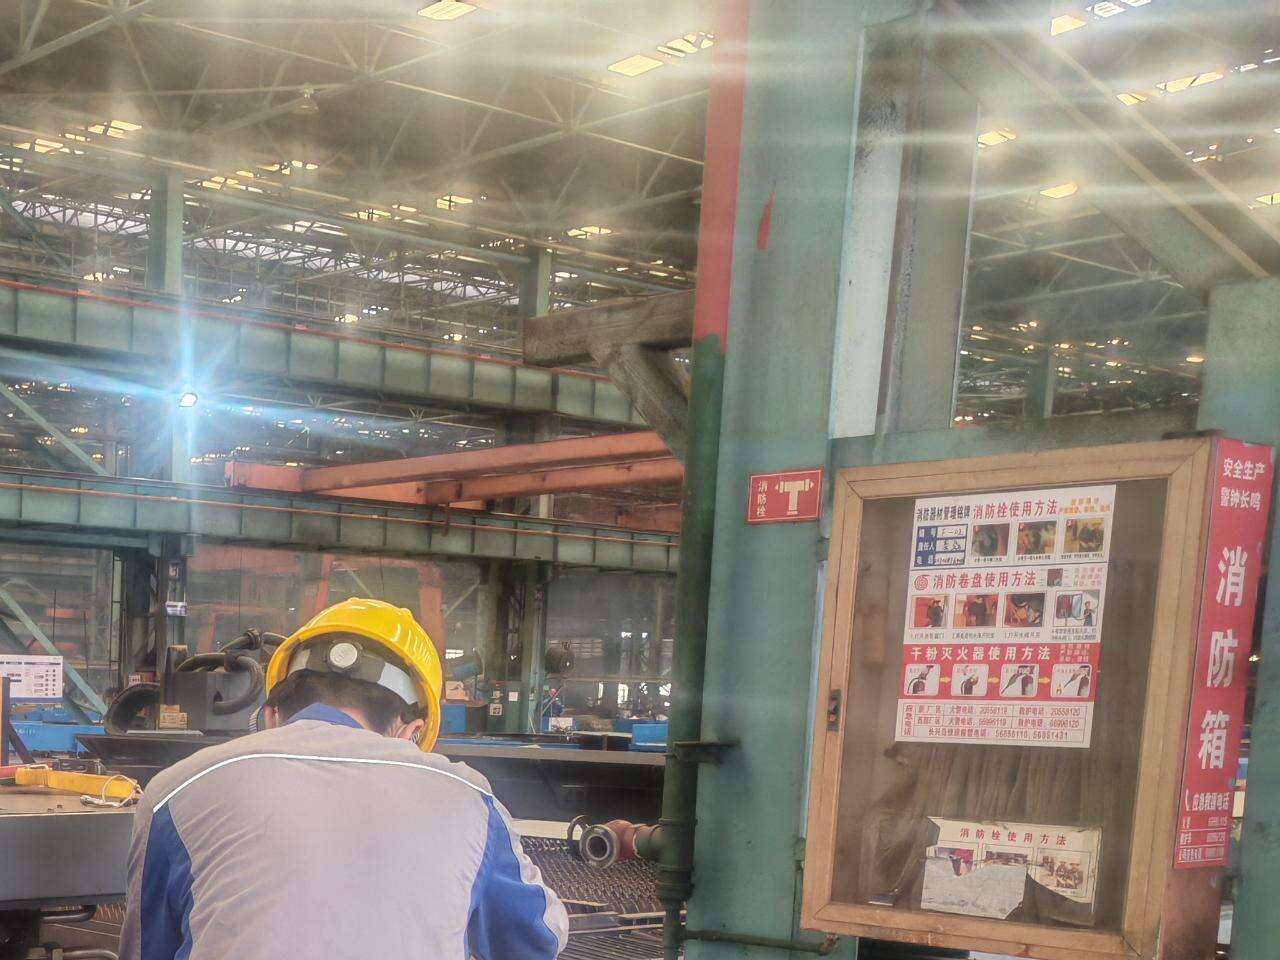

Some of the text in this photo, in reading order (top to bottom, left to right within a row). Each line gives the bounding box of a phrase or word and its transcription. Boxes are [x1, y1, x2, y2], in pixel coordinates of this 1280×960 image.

[1222, 458, 1266, 481] 安全生产
[756, 480, 769, 518] 消防栓
[972, 497, 1058, 520] 消防栓使用方法
[1219, 486, 1262, 512] 警钟长鸣
[933, 568, 1036, 590] 消防卷盘使用方法
[910, 645, 1051, 661] 干粉灭火器使用方法
[1198, 546, 1248, 770] 消防箱
[959, 827, 1068, 846] 消防栓使用方法
